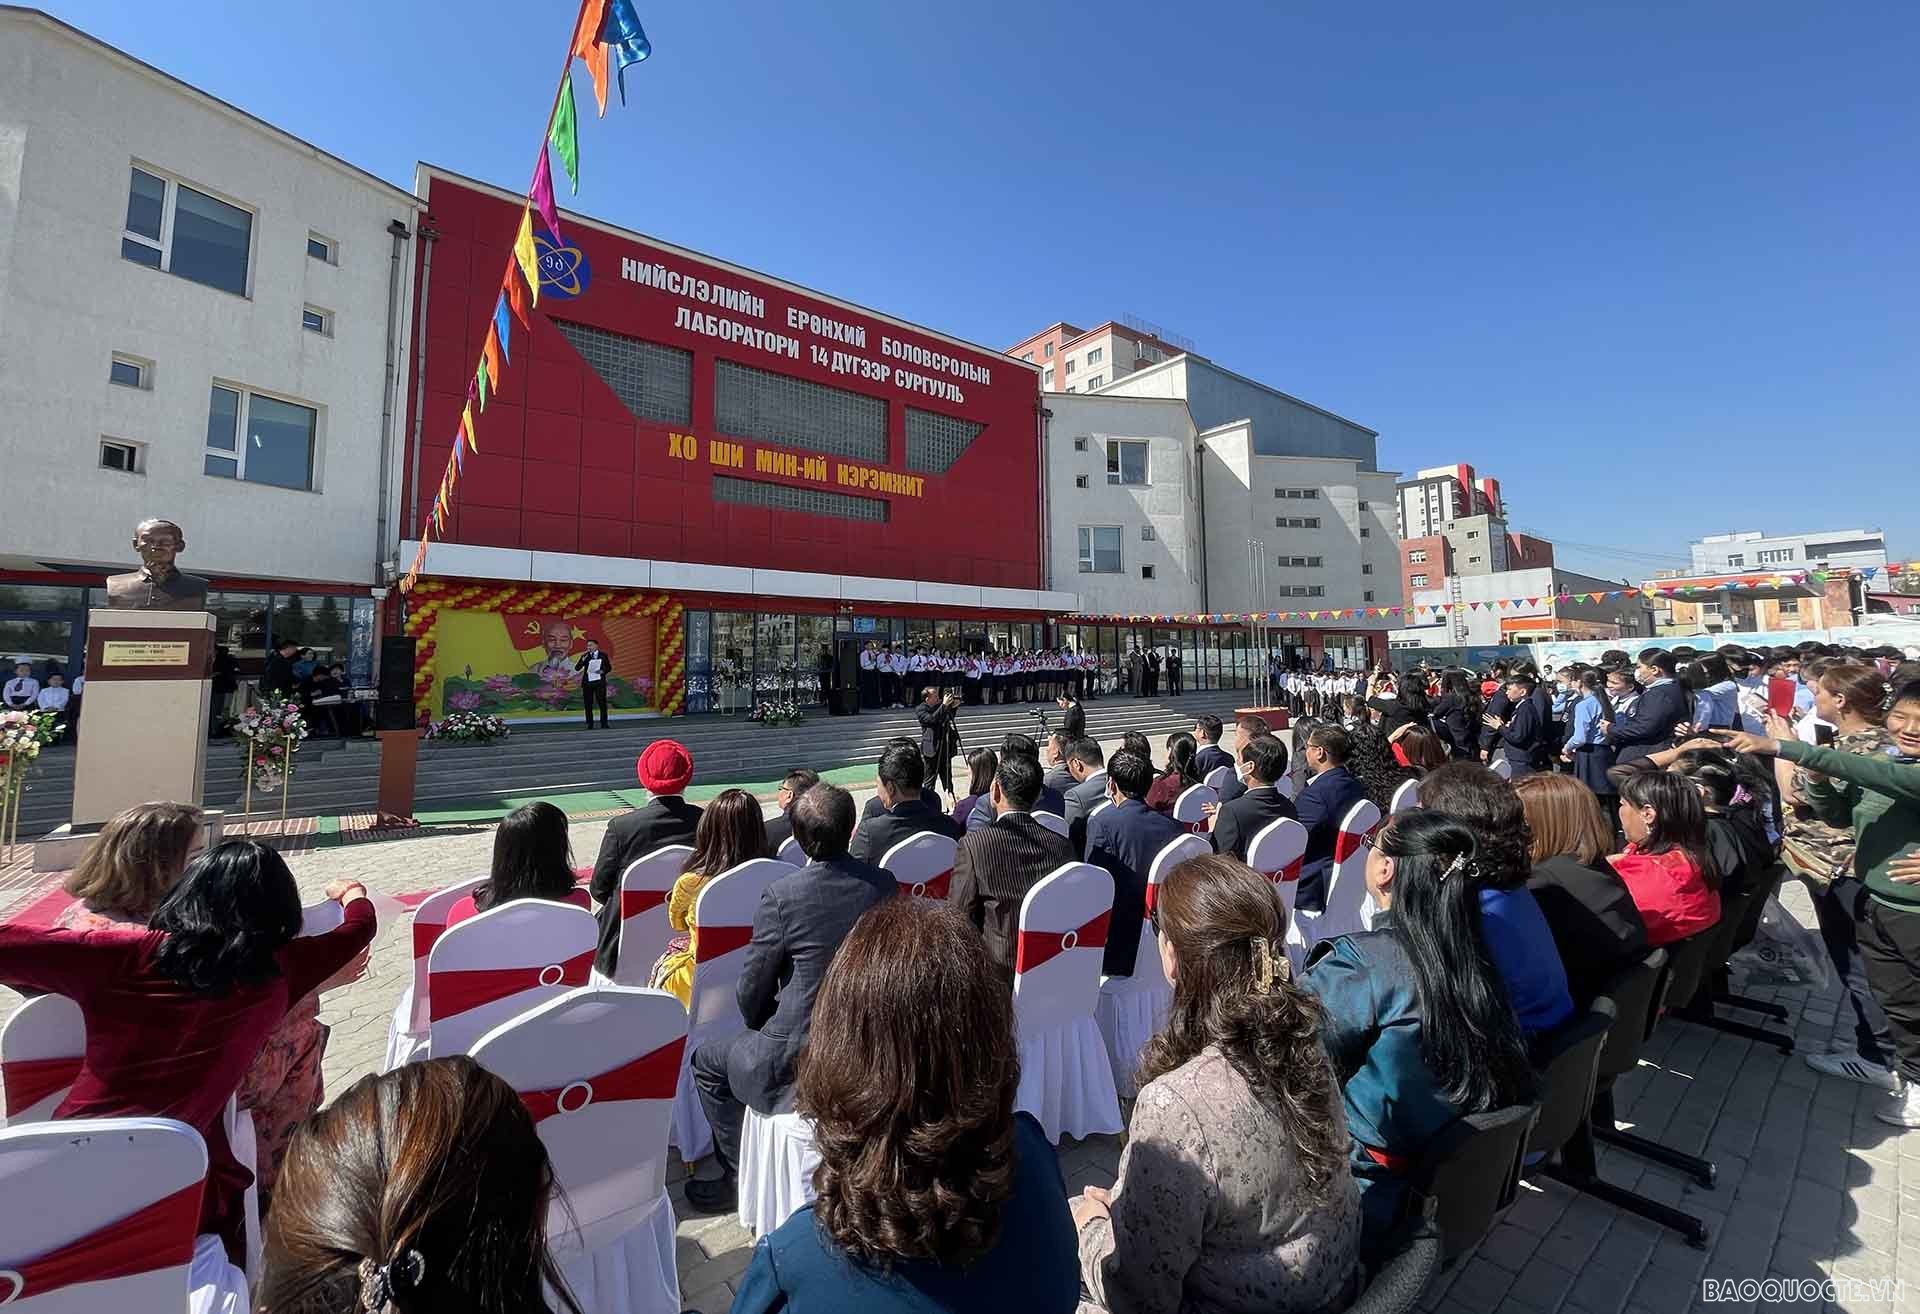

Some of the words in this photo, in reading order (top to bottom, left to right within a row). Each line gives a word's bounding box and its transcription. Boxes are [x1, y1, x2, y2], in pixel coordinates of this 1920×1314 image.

[621, 256, 765, 319] НИЙСЛЭЛИЙН
[787, 307, 867, 349] ЕРӨНХИЙ
[881, 336, 992, 385] БОЛОВСРОЛЫН
[675, 306, 800, 360] ЛАБОРАТОРИ
[810, 345, 829, 367] 14
[831, 350, 891, 383] ДҮГЭЭР
[894, 368, 965, 404] СУРГУУЛЬ
[668, 432, 698, 461] ХО
[709, 440, 744, 468] ШИ
[756, 448, 827, 482] МИН-ИЙ
[837, 463, 926, 498] НЭРЭМЖИТ
